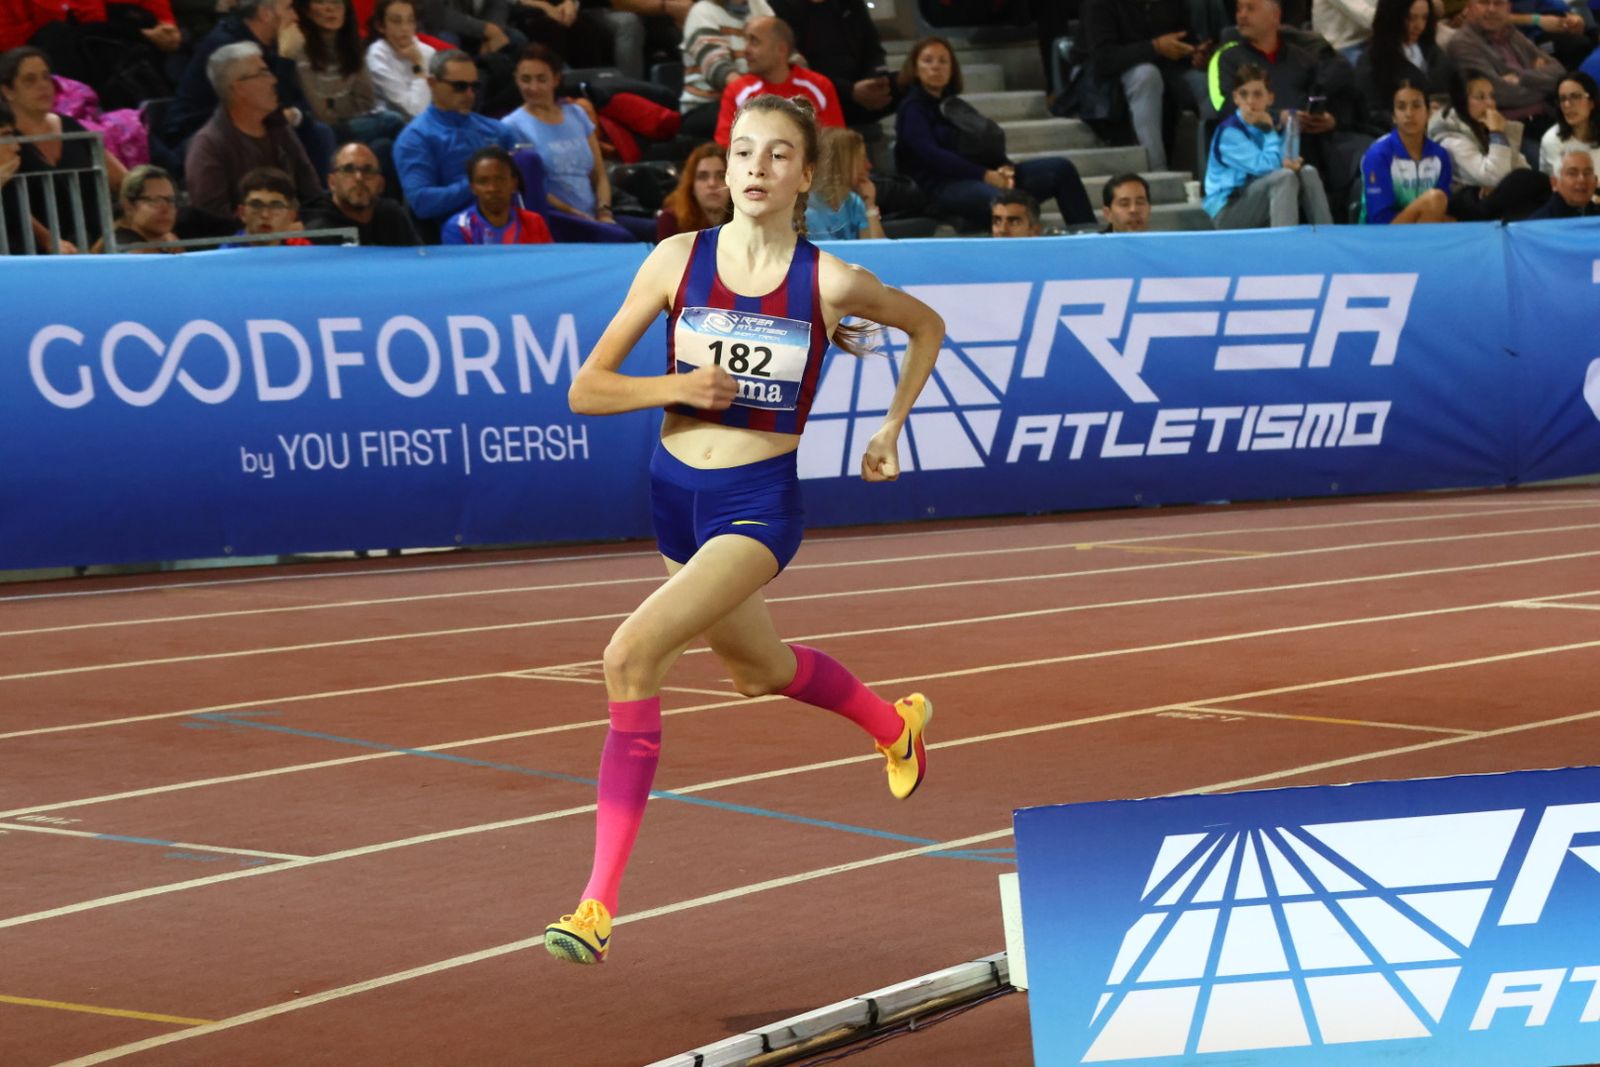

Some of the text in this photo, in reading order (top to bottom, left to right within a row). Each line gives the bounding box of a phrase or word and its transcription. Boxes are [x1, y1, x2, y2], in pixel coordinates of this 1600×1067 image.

[708, 340, 772, 377] 182
[1020, 271, 1420, 404] RFEA
[242, 424, 589, 478] by YOU FIRST GERSH
[1006, 400, 1392, 463] ATLETISMO
